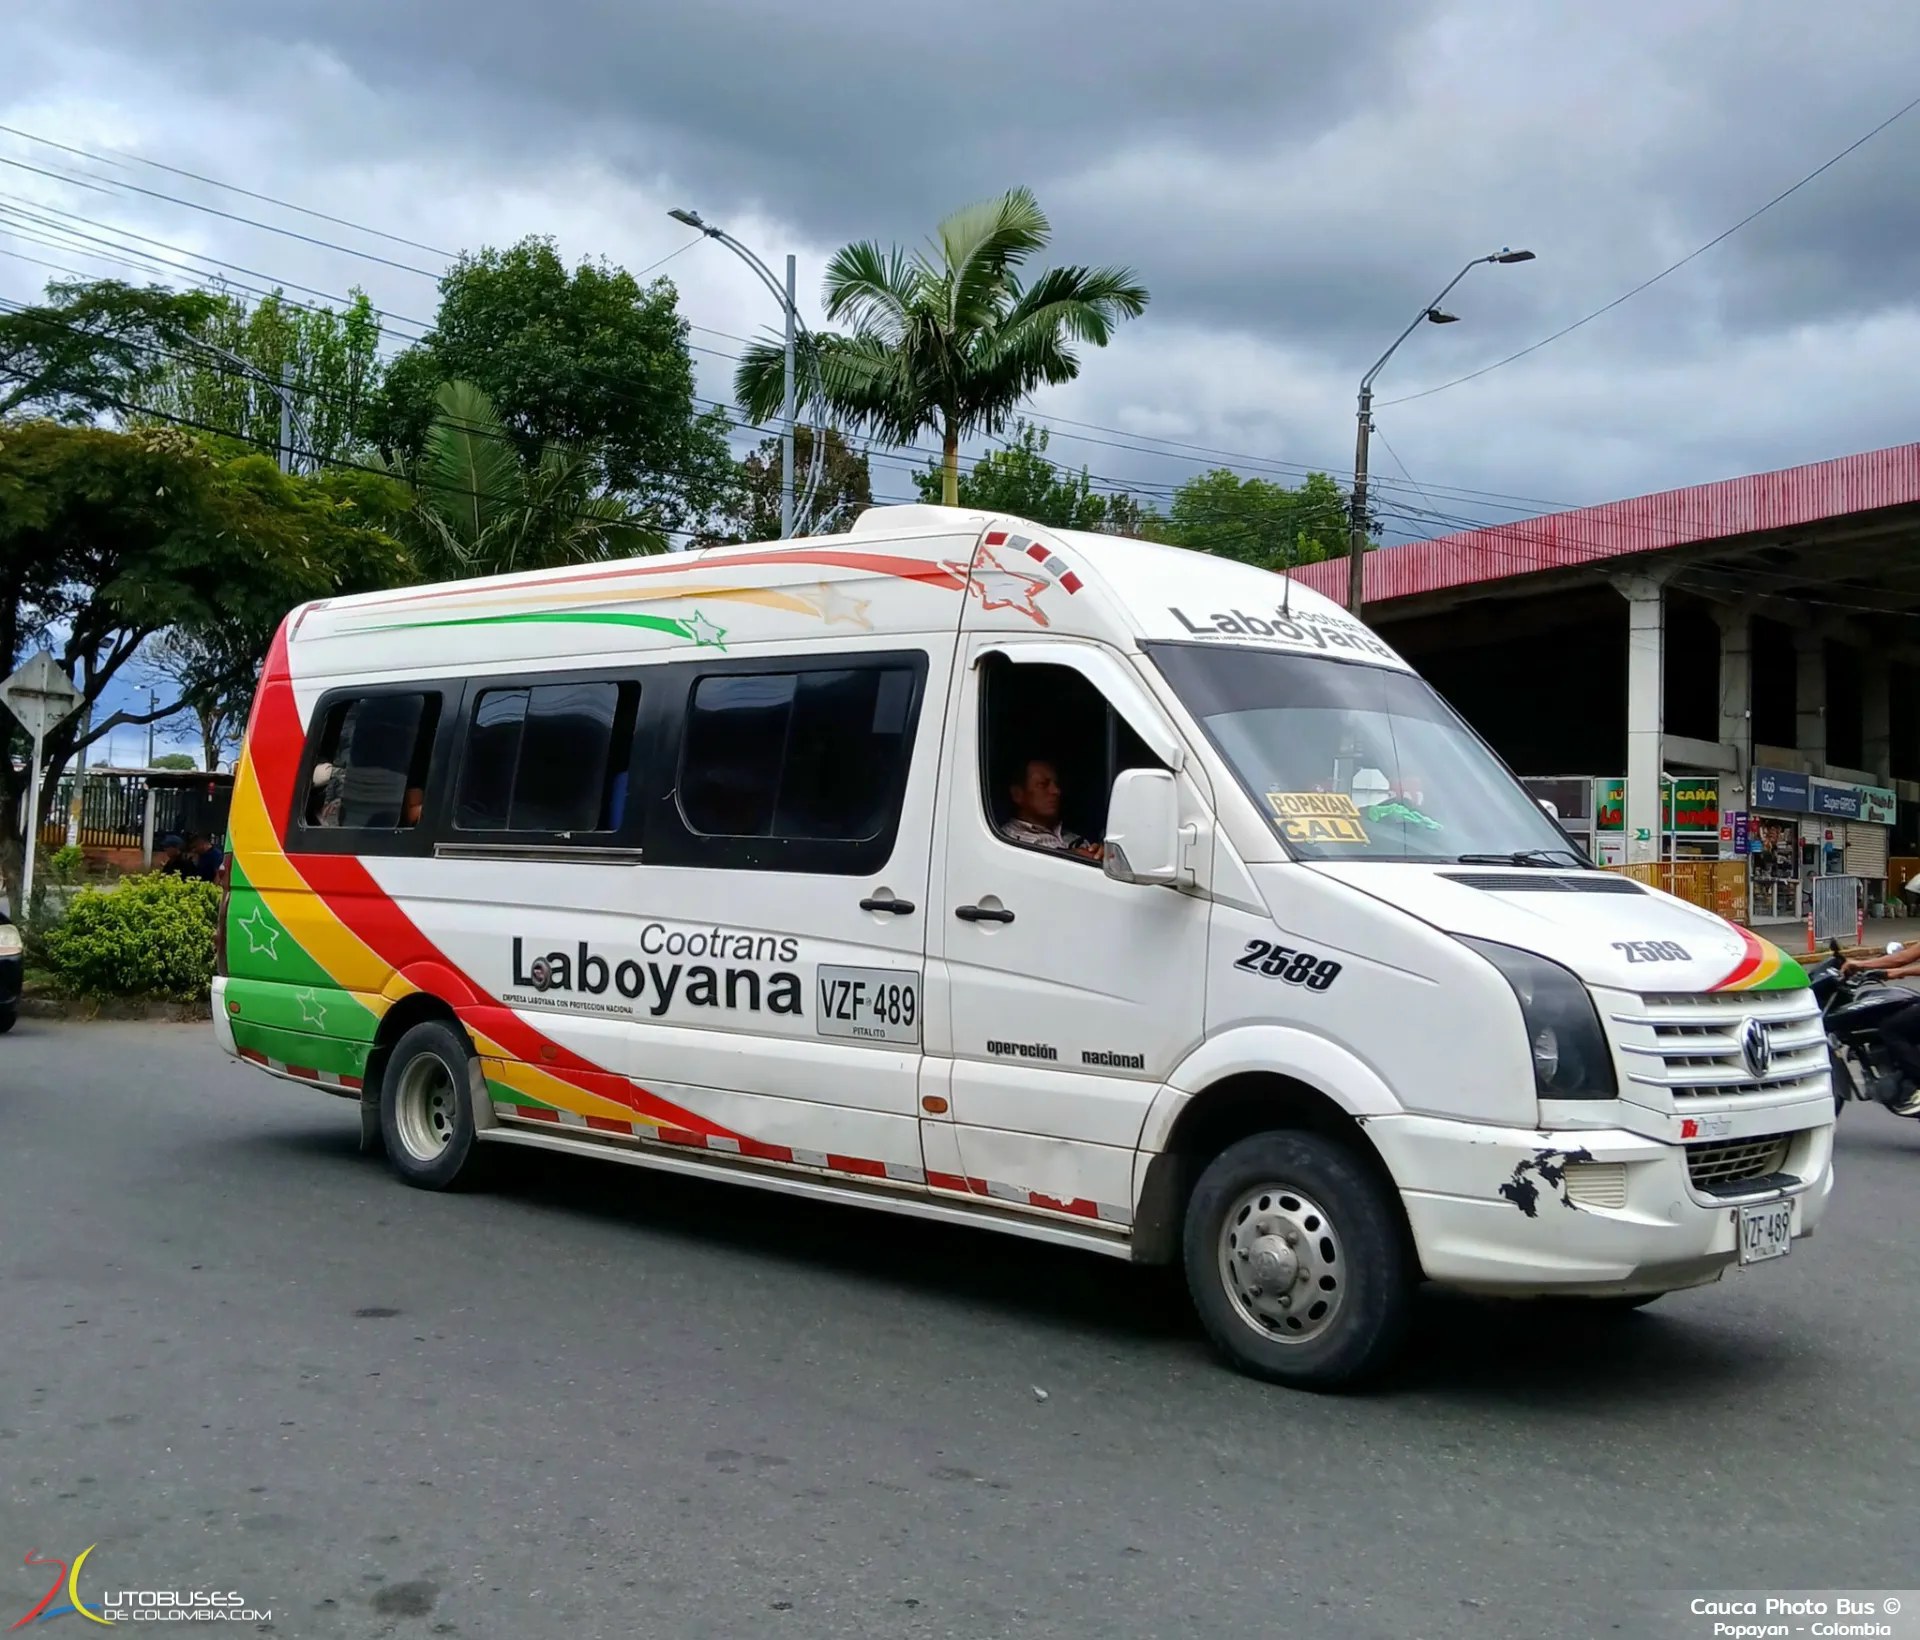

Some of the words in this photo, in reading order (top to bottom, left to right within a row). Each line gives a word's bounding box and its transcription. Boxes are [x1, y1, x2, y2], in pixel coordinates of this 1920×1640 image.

[1168, 607, 1398, 661] Laboyana
[1270, 795, 1356, 814] POPAYAN
[1676, 788, 1717, 801] CAÑA
[1280, 820, 1367, 839] CALI
[640, 923, 799, 962] Cootrans
[1611, 941, 1692, 963] 2589
[512, 936, 803, 1017] Laboyana
[1234, 939, 1343, 992] 2589
[819, 978, 867, 1021] VZF
[873, 983, 916, 1027] 489
[852, 1027, 886, 1038] PITALITO
[1082, 1050, 1145, 1069] nacional
